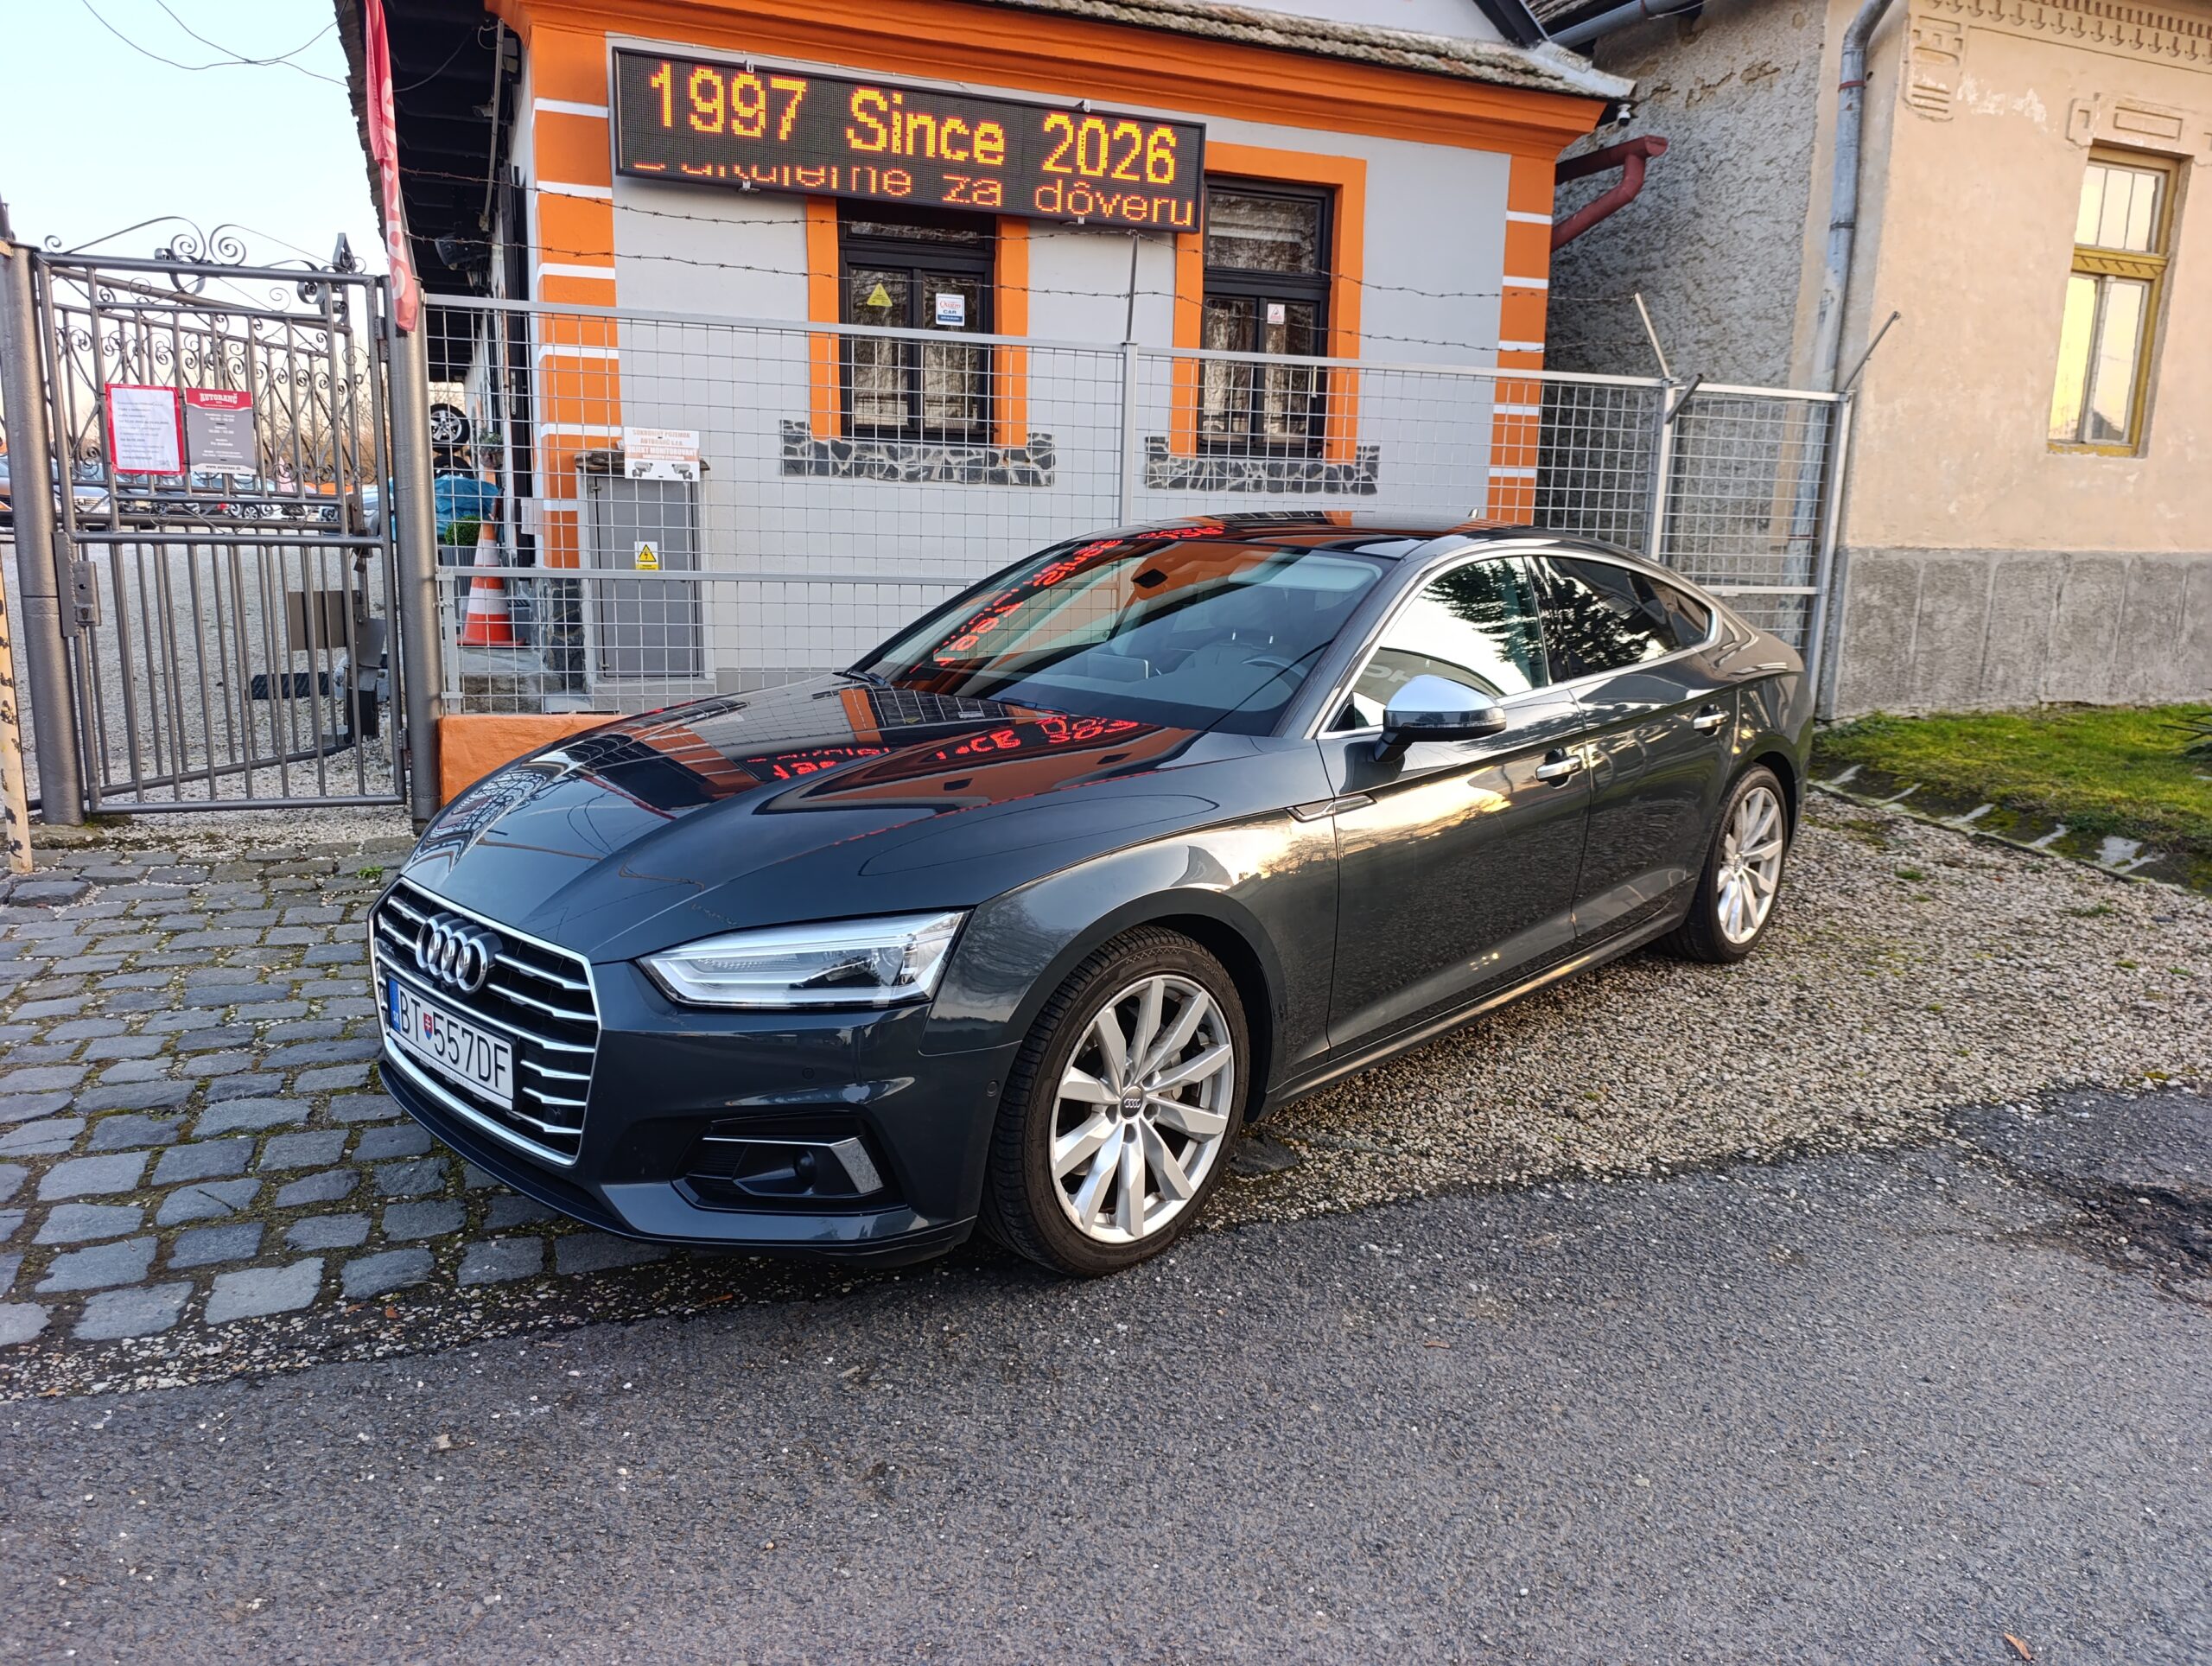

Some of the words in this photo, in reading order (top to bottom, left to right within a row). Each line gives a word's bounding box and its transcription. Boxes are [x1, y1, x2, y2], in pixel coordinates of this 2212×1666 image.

[651, 60, 807, 141] 1997
[846, 87, 1005, 166] Since
[1041, 112, 1177, 185] 2026
[942, 174, 1002, 207] za
[1034, 178, 1193, 227] dôveru
